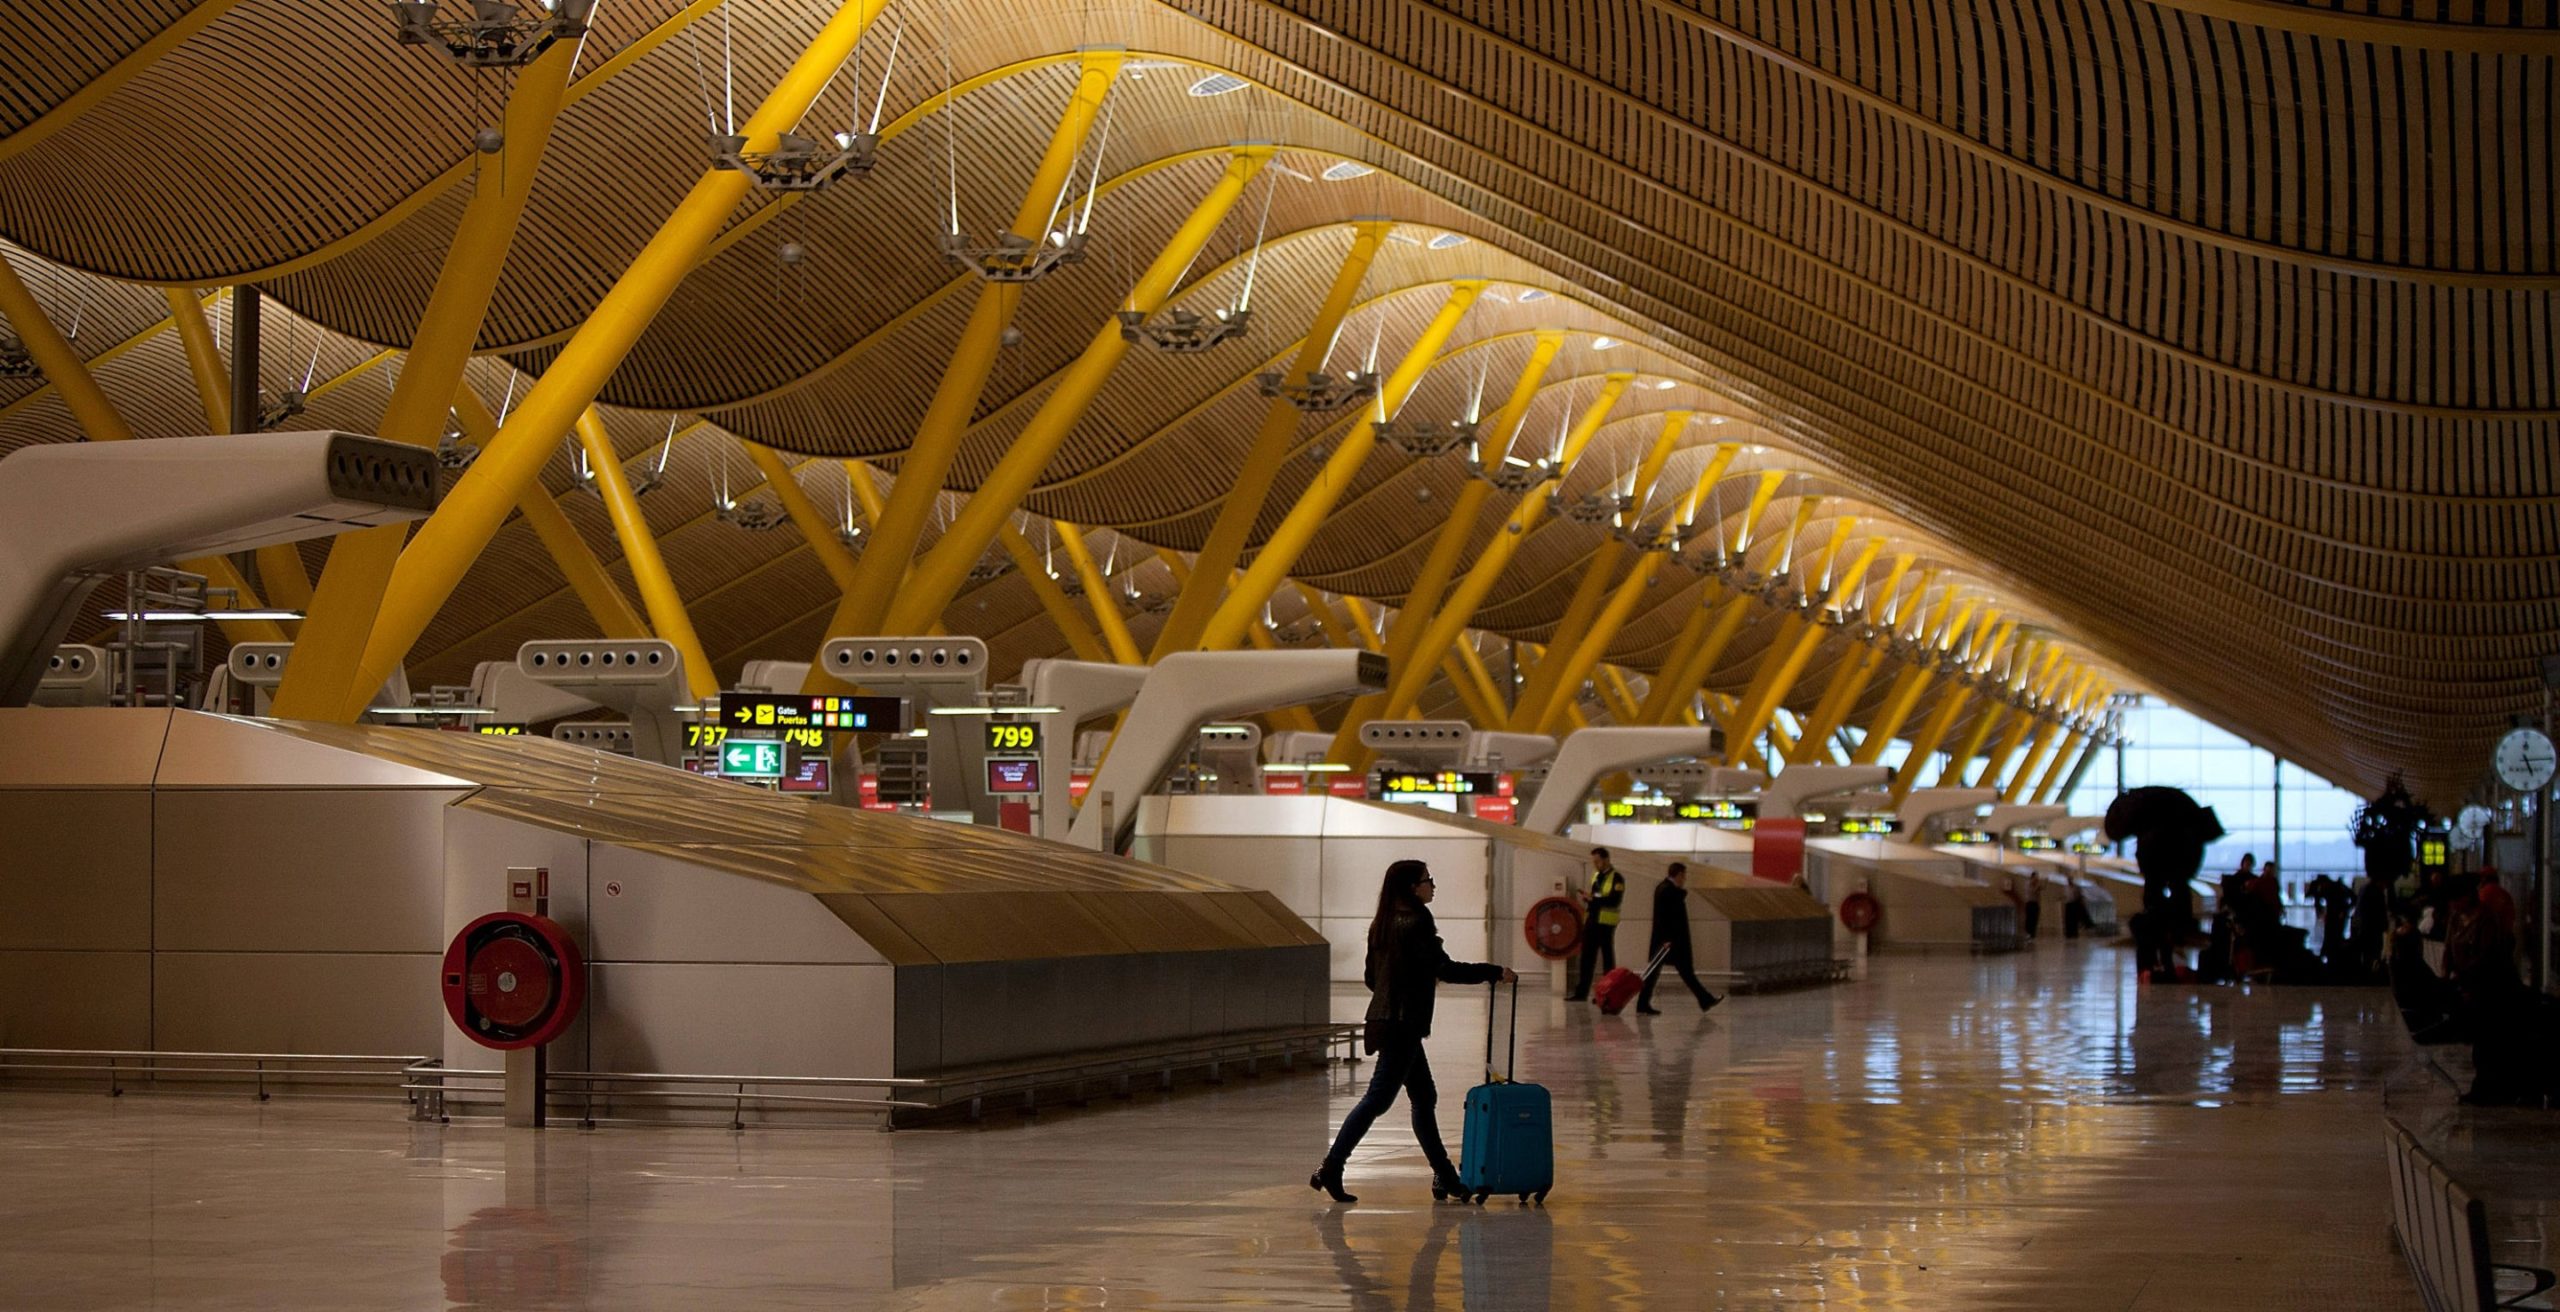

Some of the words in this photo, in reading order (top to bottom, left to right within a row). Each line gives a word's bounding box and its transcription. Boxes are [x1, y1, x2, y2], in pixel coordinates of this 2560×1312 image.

[812, 699, 822, 710] H
[842, 699, 851, 710] K
[777, 706, 798, 715] Gates
[777, 716, 808, 724] Puertas
[812, 714, 823, 724] M
[857, 714, 866, 725] U
[991, 726, 1034, 748] 799
